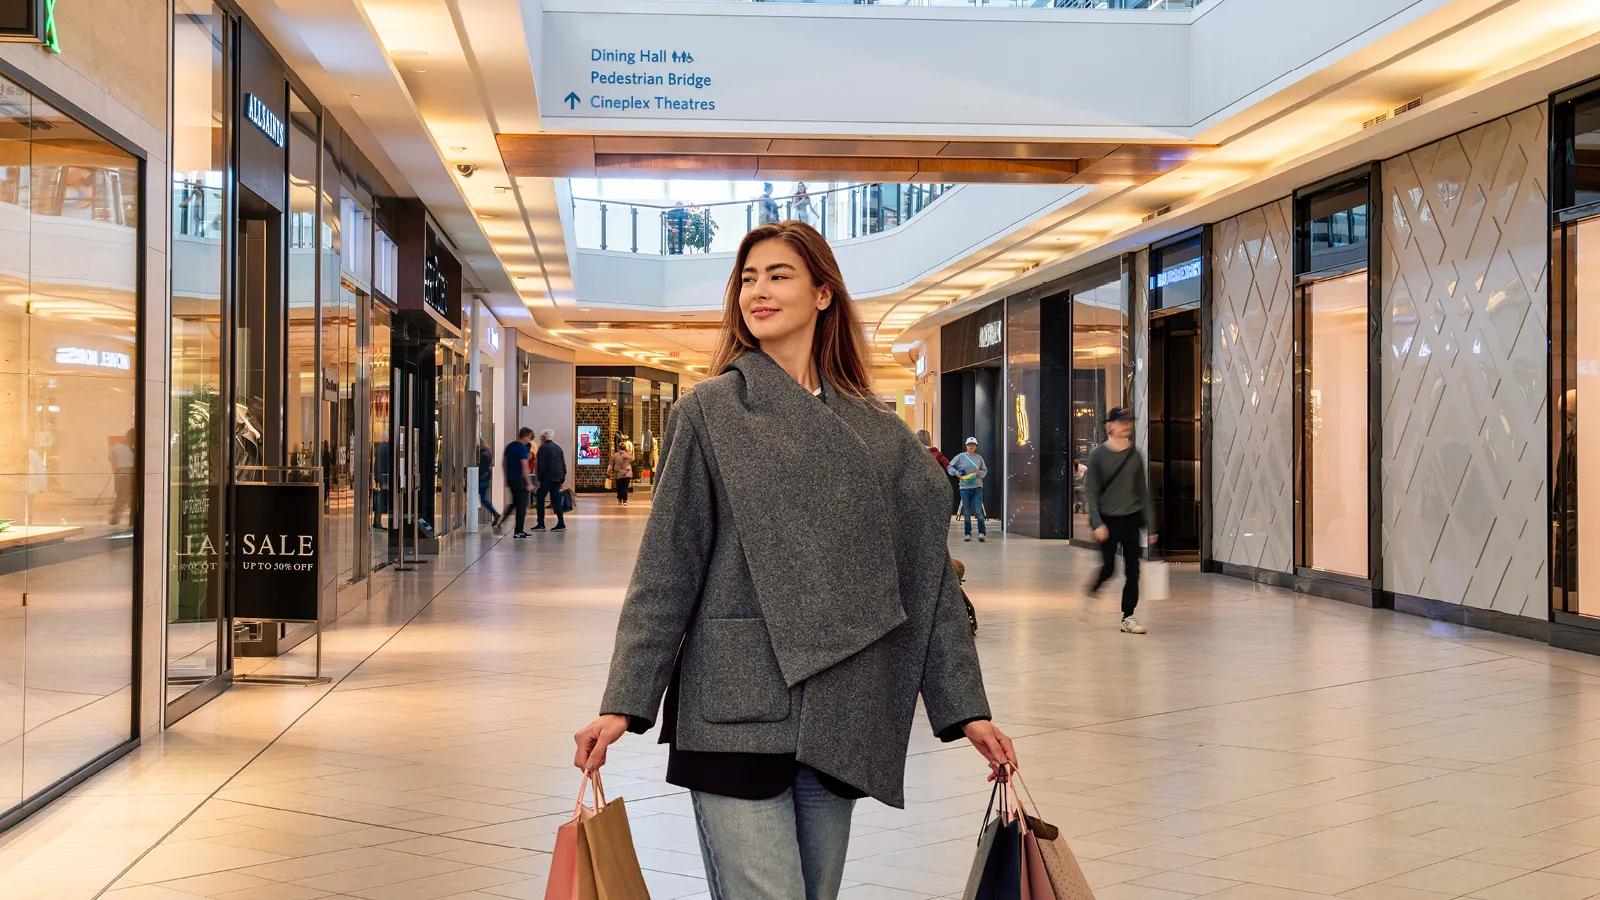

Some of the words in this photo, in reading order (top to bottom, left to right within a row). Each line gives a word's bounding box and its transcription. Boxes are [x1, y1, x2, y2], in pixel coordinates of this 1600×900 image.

[591, 48, 636, 65] Dining
[640, 49, 667, 63] Hall
[591, 71, 663, 86] Pedestrian
[668, 73, 712, 89] Bridge
[590, 95, 650, 111] Cineplex
[654, 96, 715, 111] Theatres
[248, 92, 284, 148] ALLSAINTS
[242, 533, 314, 556] SALE
[242, 561, 257, 570] UP
[257, 562, 272, 571] TO
[273, 562, 292, 571] 50%
[293, 563, 314, 572] OFF
